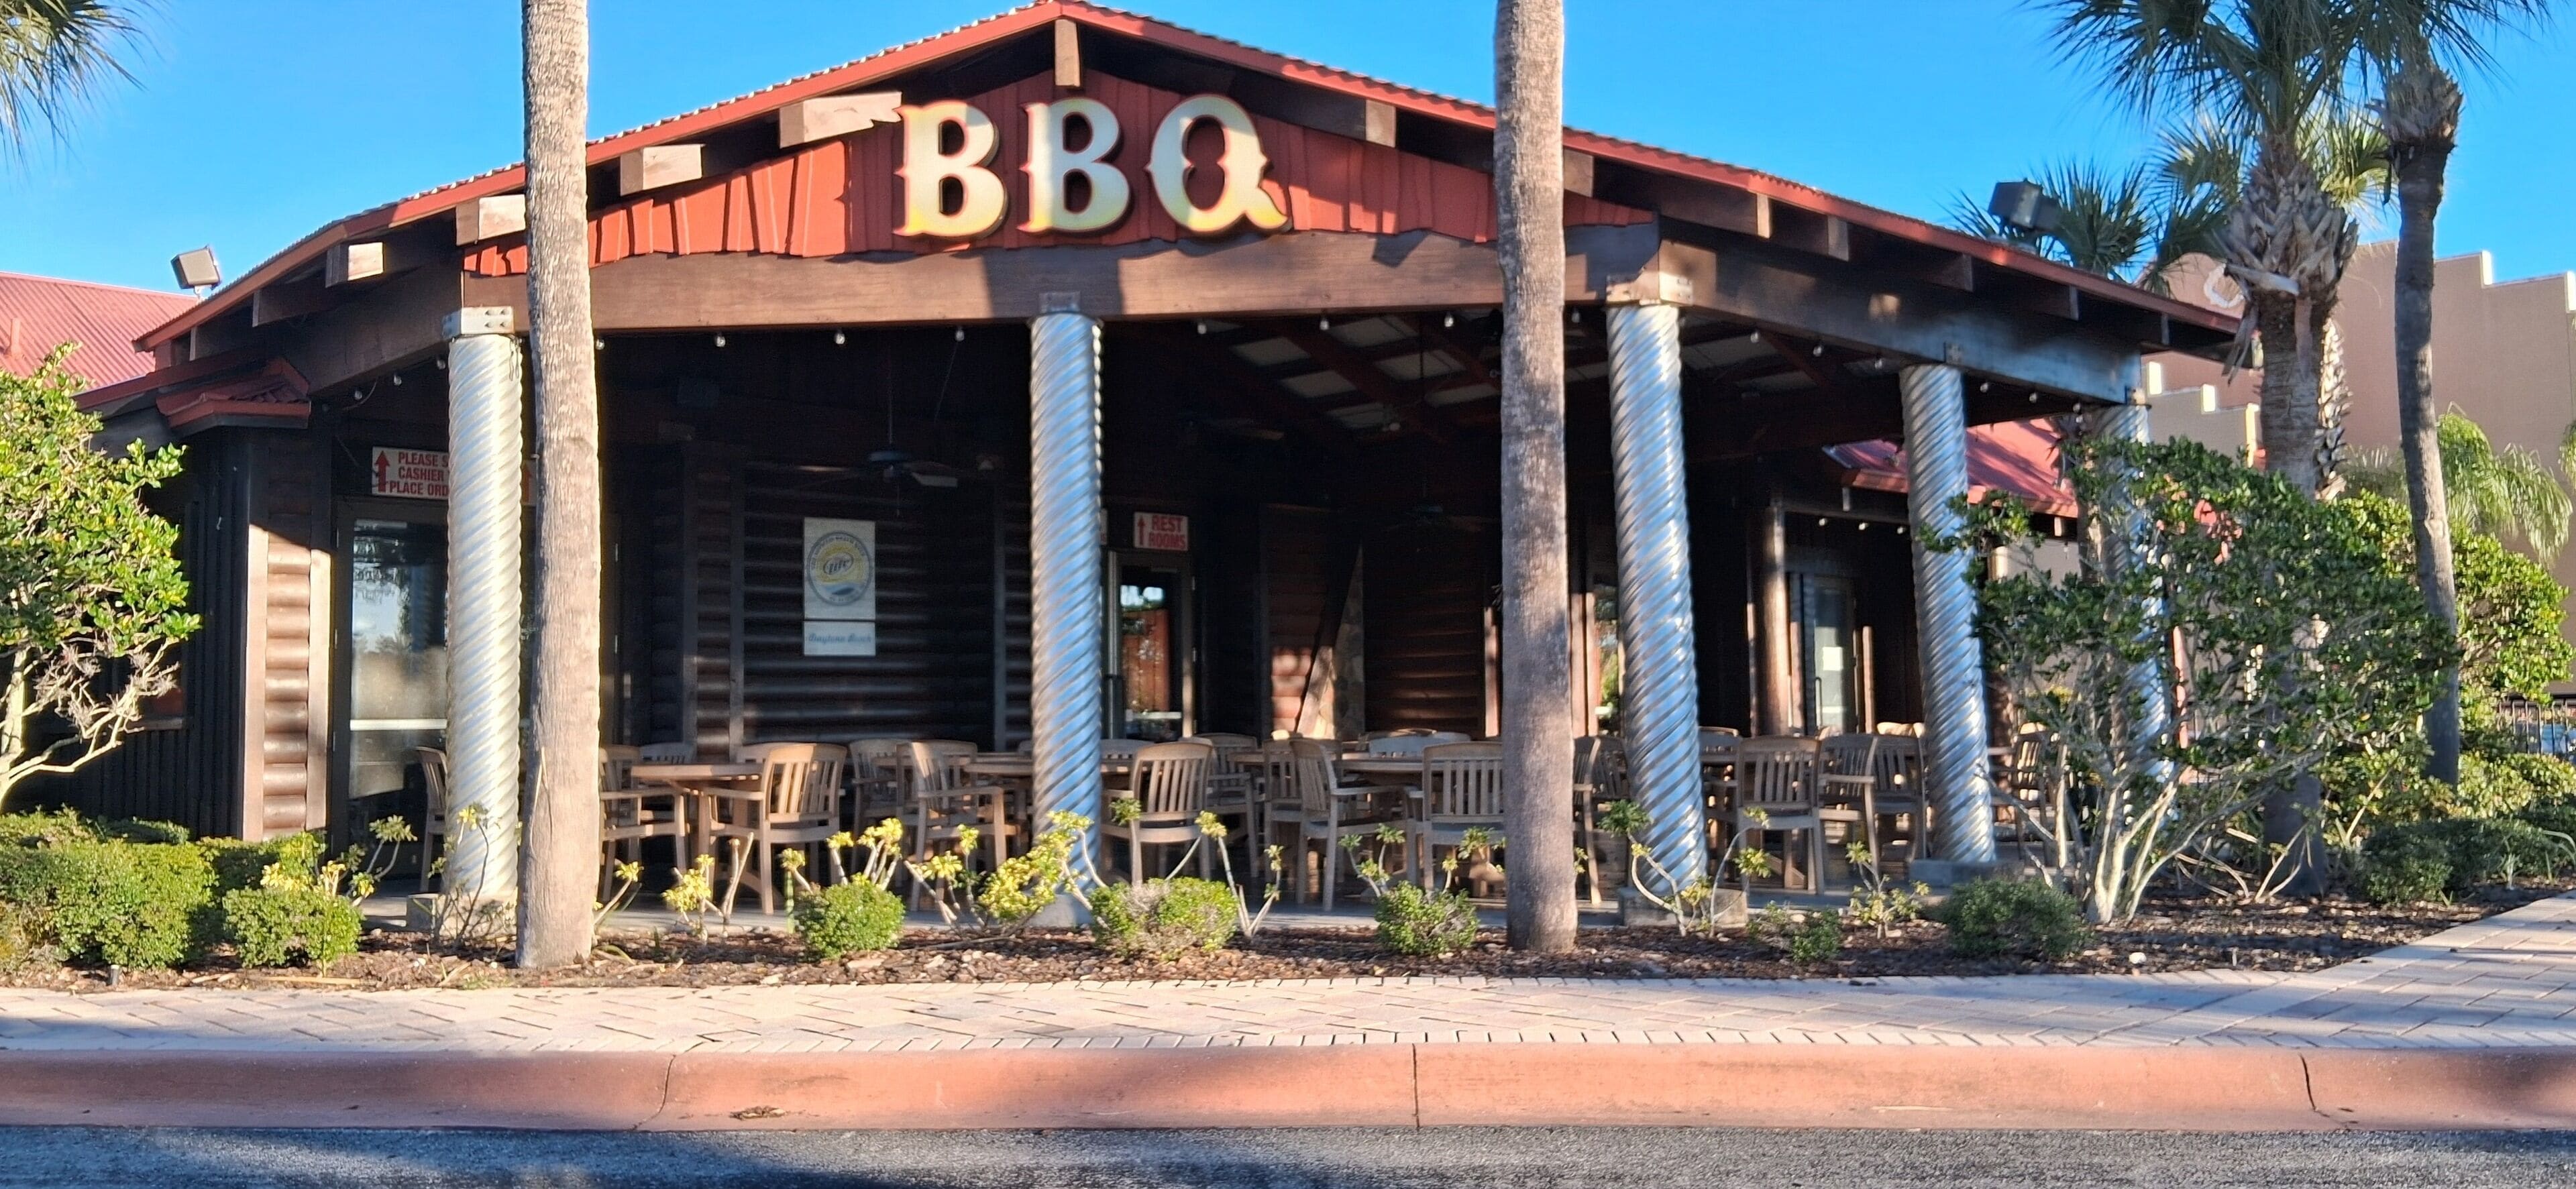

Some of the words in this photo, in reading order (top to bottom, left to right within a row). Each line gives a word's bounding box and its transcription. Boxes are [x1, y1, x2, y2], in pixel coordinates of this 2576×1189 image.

[893, 93, 1291, 237] BBQ
[398, 451, 438, 467] PLEASE
[398, 466, 443, 482] CASHIER
[390, 480, 423, 495] PLACE
[427, 484, 449, 496] ORD
[1152, 514, 1183, 532] REST
[1148, 532, 1186, 550] ROOMS
